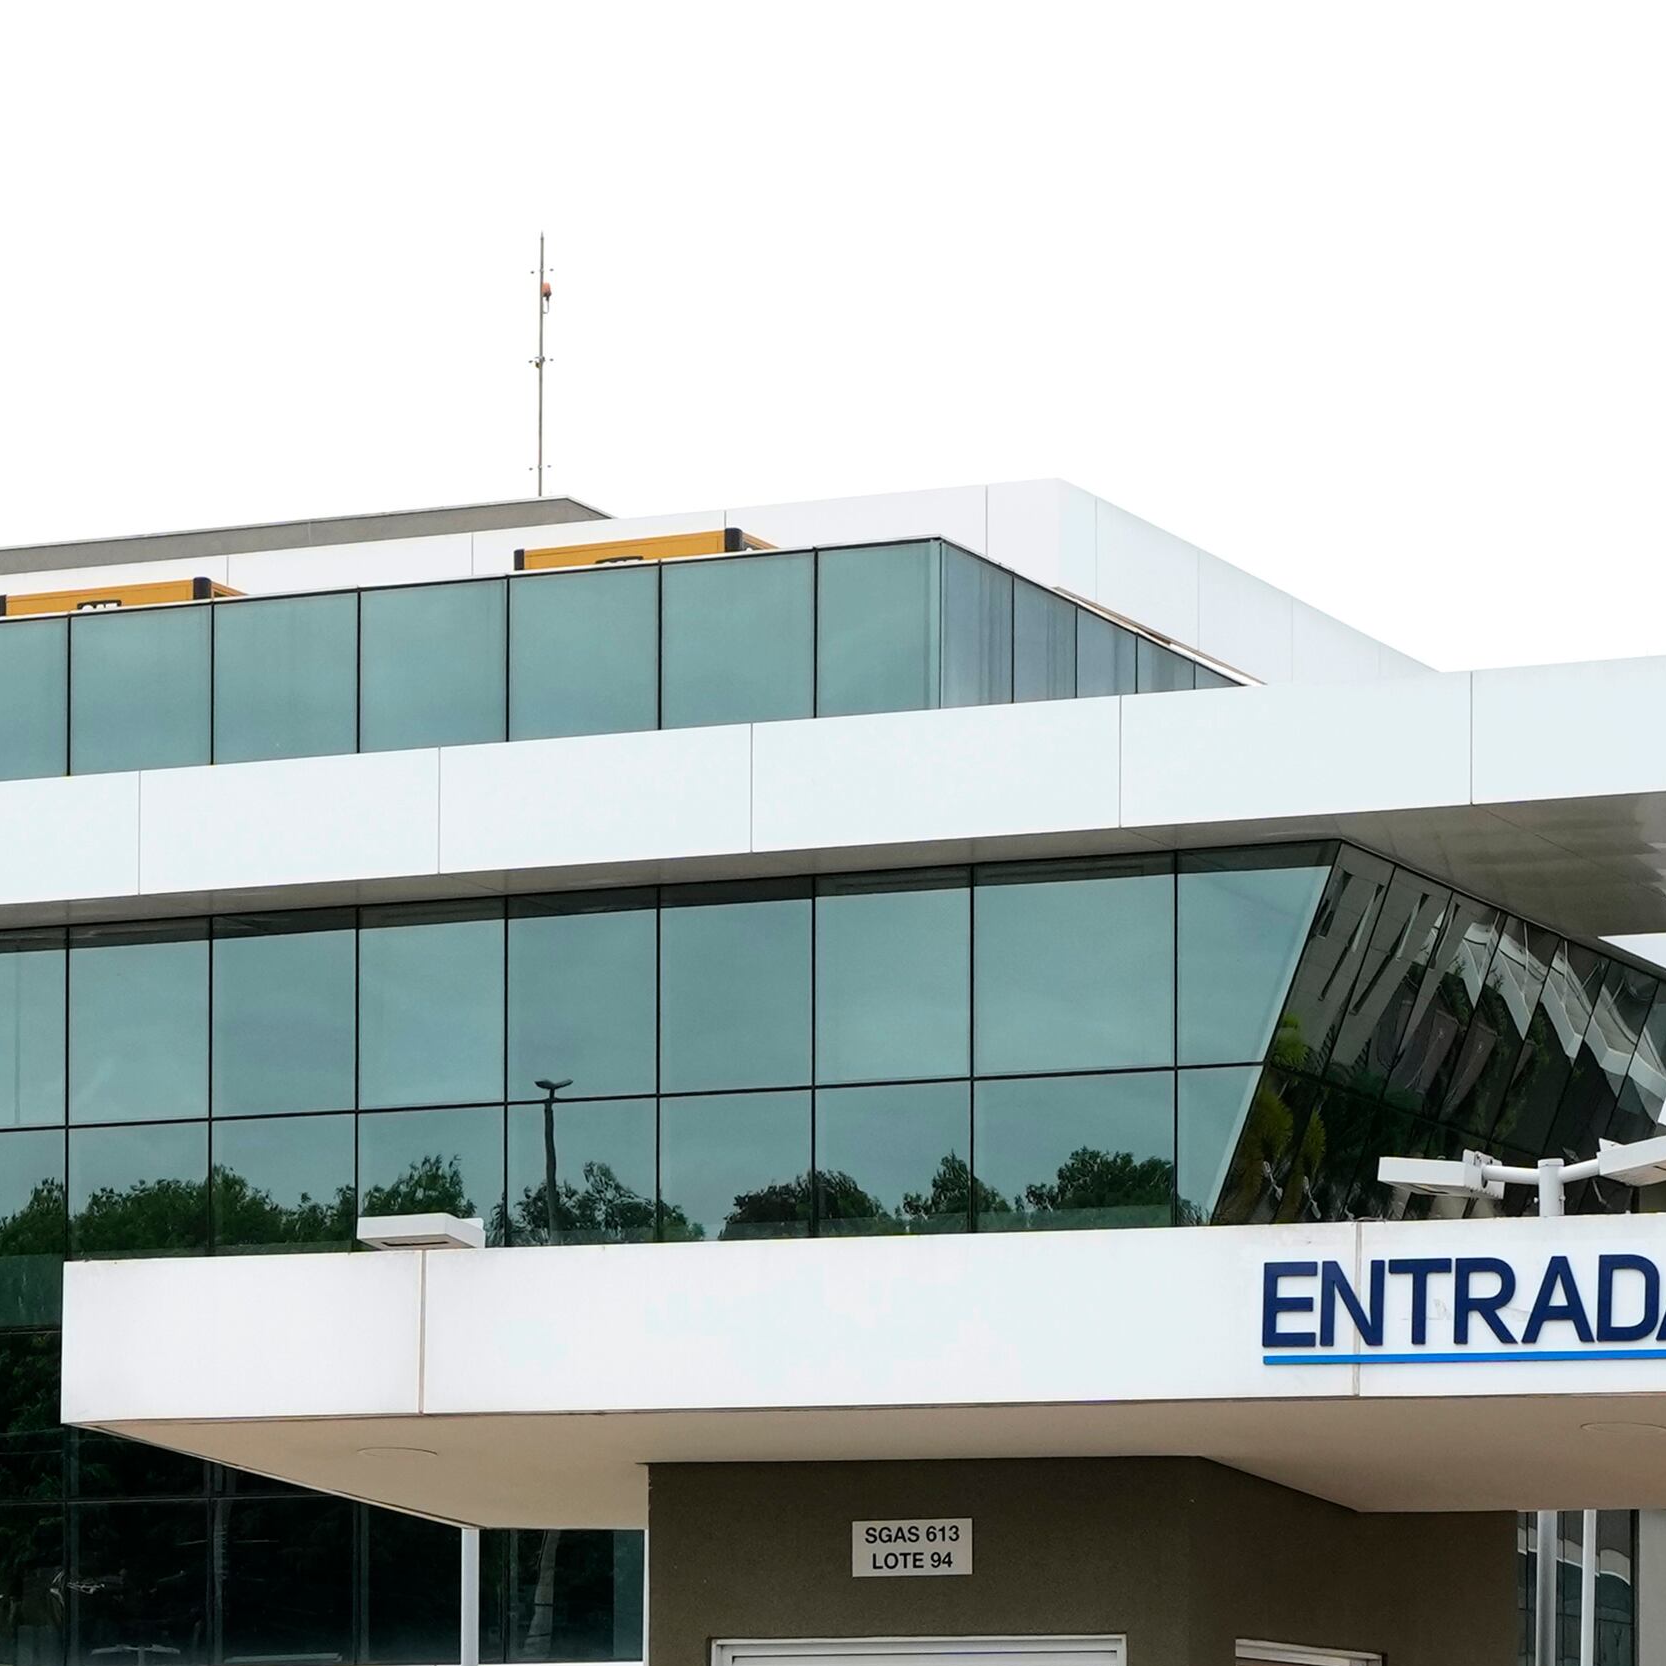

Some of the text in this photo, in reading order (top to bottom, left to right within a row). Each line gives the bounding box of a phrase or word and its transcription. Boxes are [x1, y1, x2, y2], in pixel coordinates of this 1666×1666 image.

[864, 1525, 960, 1543] SGAS 613
[872, 1552, 953, 1569] LOTE 94
